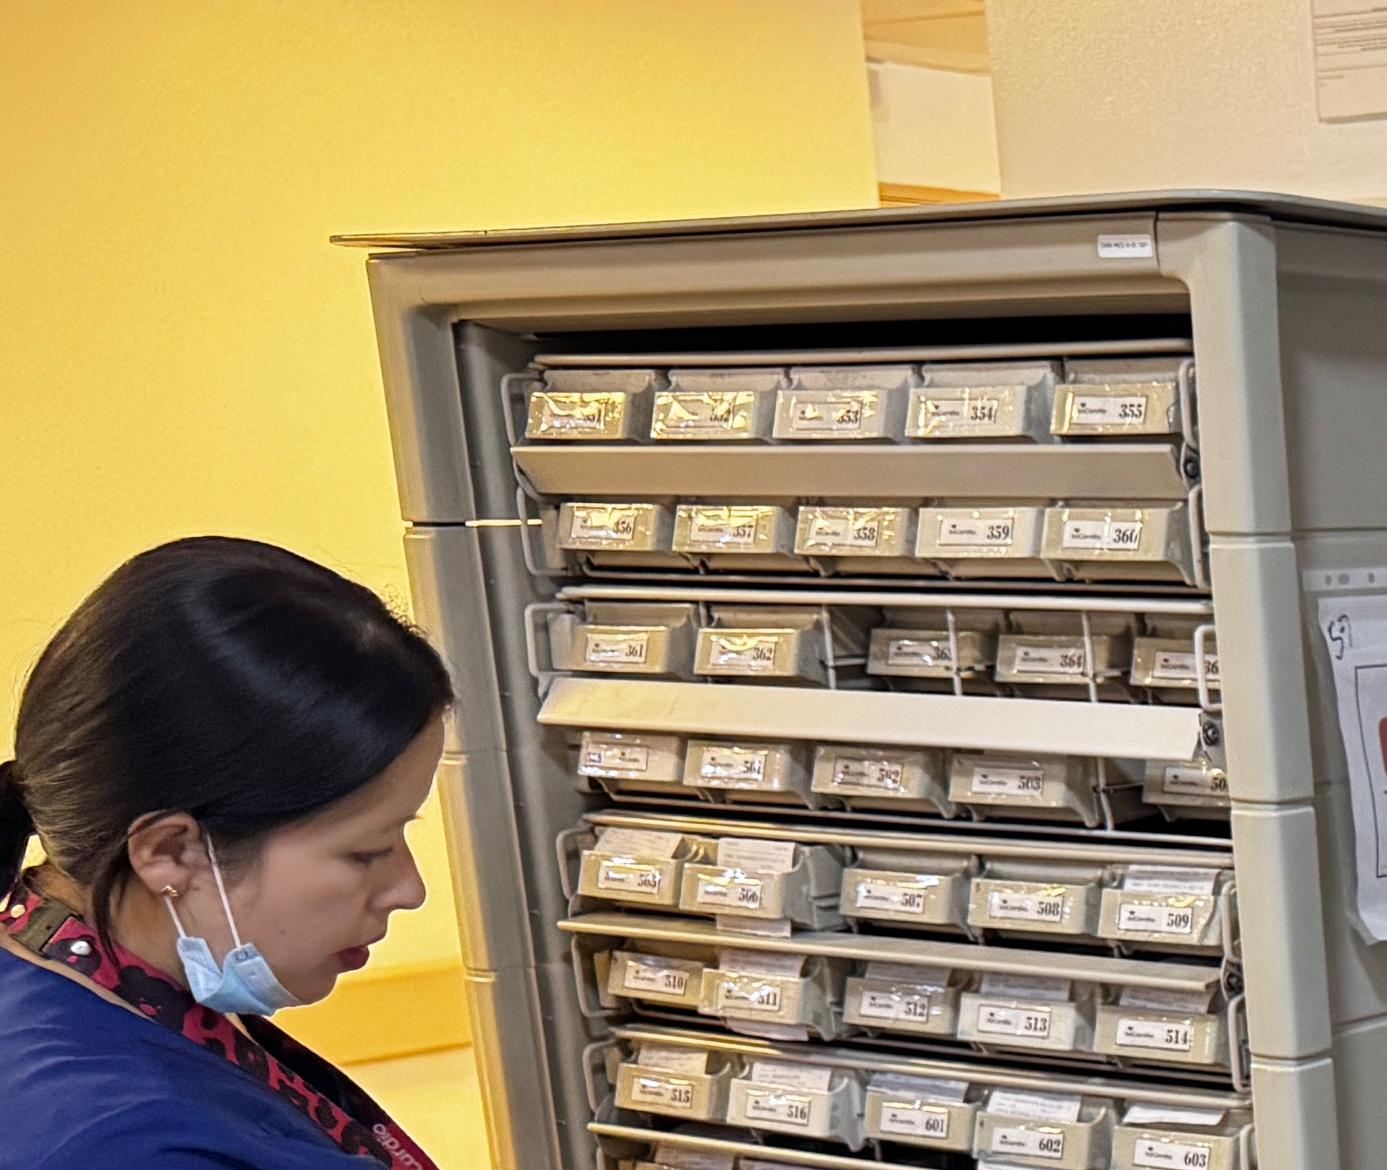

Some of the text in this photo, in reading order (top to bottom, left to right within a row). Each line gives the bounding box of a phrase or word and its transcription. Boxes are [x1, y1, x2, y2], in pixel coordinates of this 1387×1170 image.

[971, 406, 993, 421] 354
[1118, 404, 1143, 419] 355
[853, 526, 876, 541] 358
[987, 525, 1010, 540] 359
[626, 645, 643, 657] 361
[753, 647, 773, 661] 362
[1018, 775, 1042, 791] 503
[738, 887, 759, 903] 506
[899, 893, 923, 909] 507
[1036, 901, 1061, 917] 508
[1166, 913, 1190, 929] 509
[664, 974, 685, 989] 510
[904, 1001, 926, 1017] 512
[1024, 1017, 1048, 1032] 513
[1165, 1029, 1189, 1045] 514
[670, 1089, 691, 1104] 515
[787, 1104, 808, 1121] 516
[925, 1118, 945, 1133] 601
[1038, 1137, 1062, 1153] 602
[1184, 1151, 1207, 1168] 603
